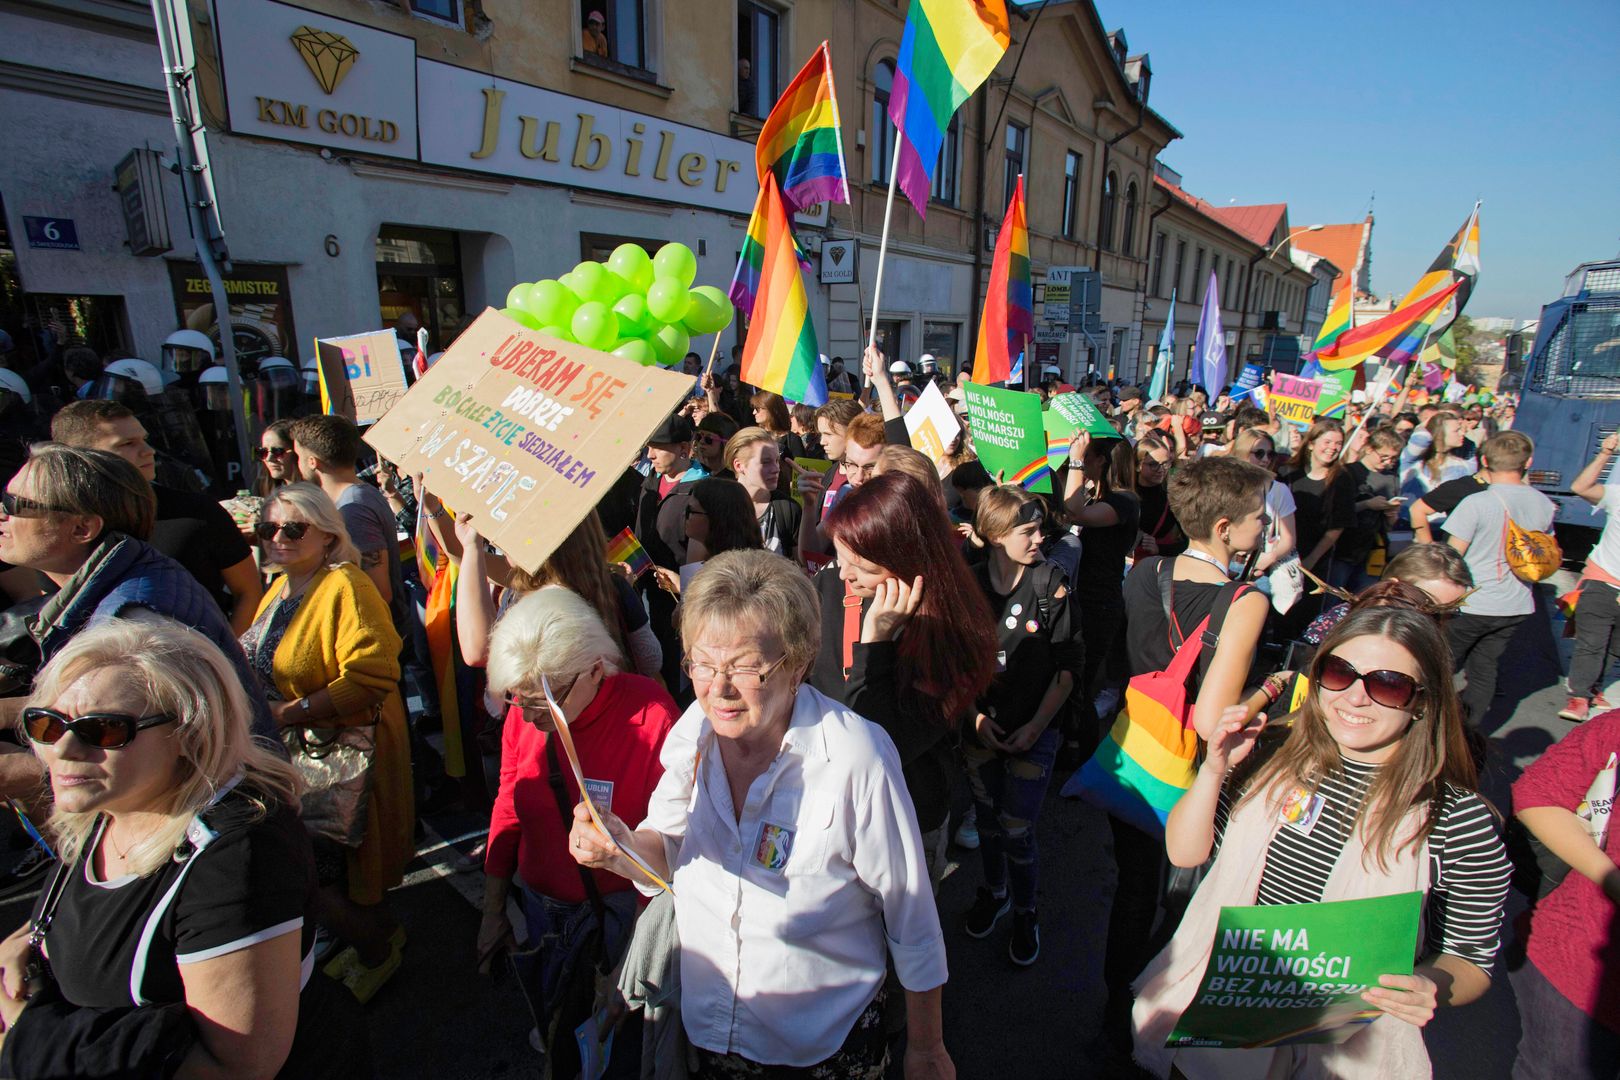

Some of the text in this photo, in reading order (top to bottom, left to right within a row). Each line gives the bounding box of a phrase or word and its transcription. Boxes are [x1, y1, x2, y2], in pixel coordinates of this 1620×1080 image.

[255, 96, 400, 144] KM GOLD
[470, 88, 740, 193] Jubiler
[43, 221, 60, 240] 6
[324, 234, 341, 257] 6
[833, 270, 852, 278] GOLD
[1049, 269, 1072, 281] ANT
[185, 278, 279, 295] ZEGRMISTRZ
[341, 344, 371, 380] BI
[489, 335, 586, 397] UBIERAM
[1276, 377, 1288, 393] I
[1288, 380, 1321, 399] JUST
[500, 385, 574, 432] DOBRZE
[967, 391, 997, 409] NIE MA
[968, 403, 1015, 425] WOLNOŚCI
[1300, 404, 1314, 420] TO
[971, 416, 1025, 439] BEZ MARSZU
[973, 429, 1019, 450] RÓWNOŚCI
[518, 431, 596, 489] SIEDZIAŁEM
[420, 423, 538, 521] W SZAFIE
[1222, 928, 1309, 951] NIE MA
[1216, 952, 1351, 978] WOLNOŚCI
[1207, 976, 1366, 996] BEZ MARSZU
[1199, 992, 1334, 1009] RÓWNOŚCI
